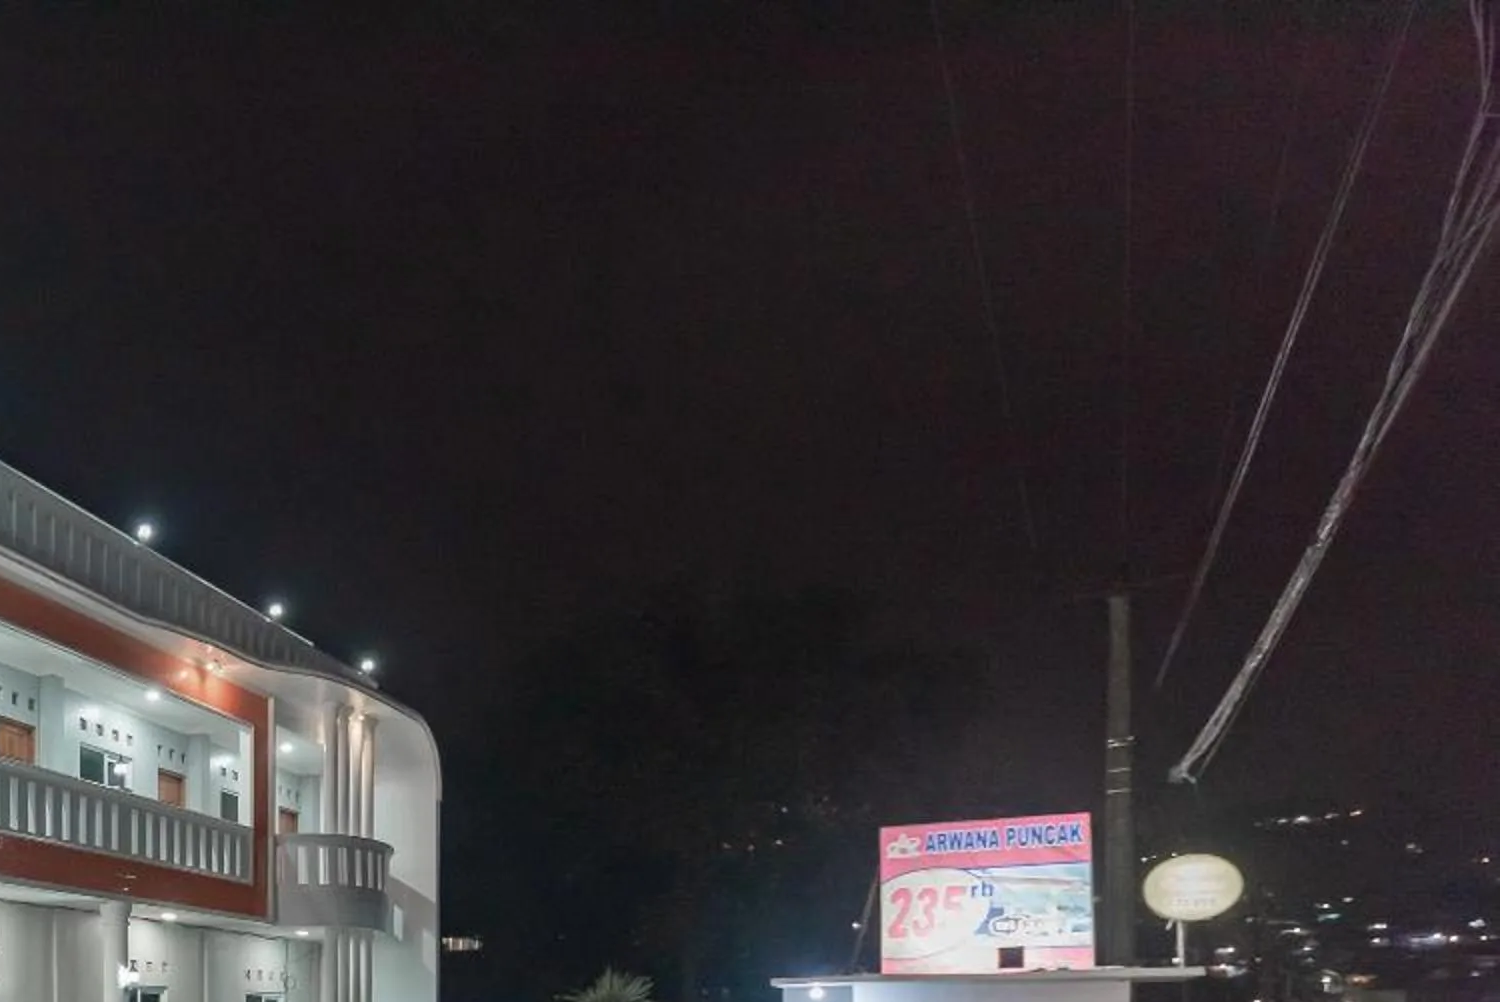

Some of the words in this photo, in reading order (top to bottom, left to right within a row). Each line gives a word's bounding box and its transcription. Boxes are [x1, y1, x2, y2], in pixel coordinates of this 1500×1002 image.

[924, 828, 1000, 854] ARWANA
[1005, 821, 1084, 848] PUNCAK
[887, 884, 967, 940] 235
[970, 881, 995, 898] rb
